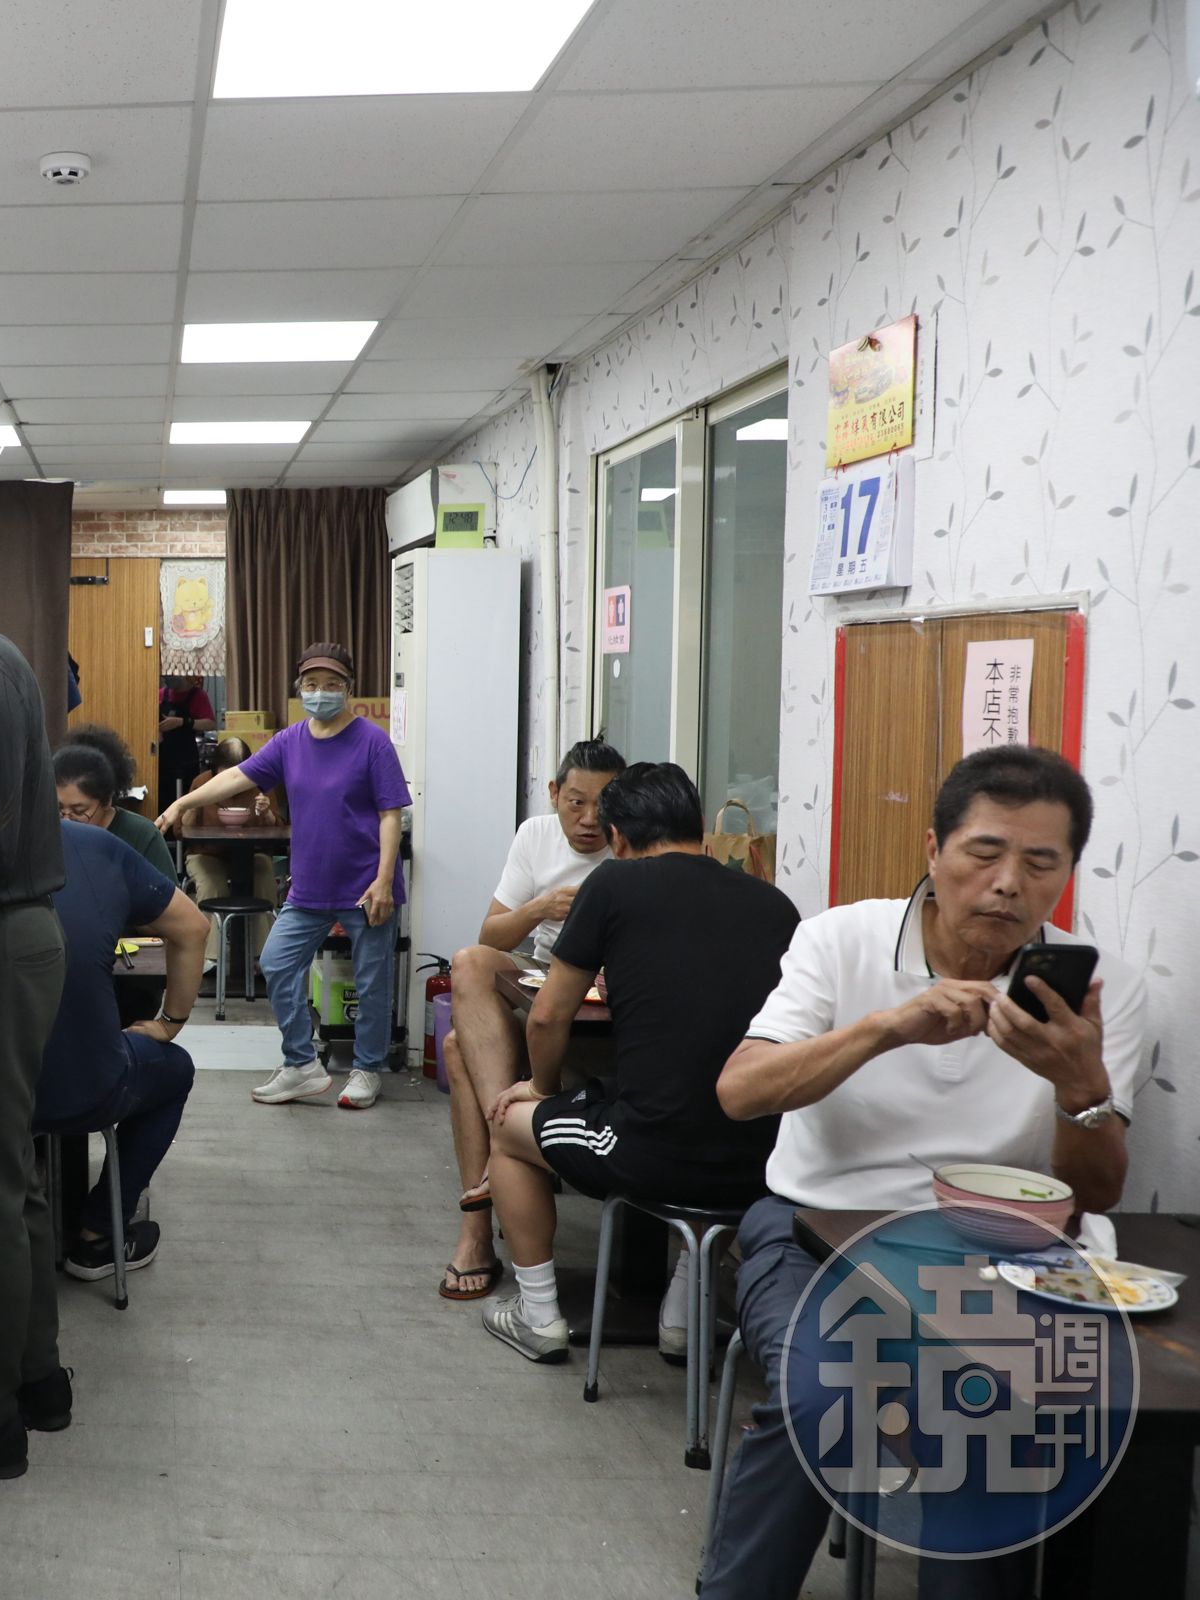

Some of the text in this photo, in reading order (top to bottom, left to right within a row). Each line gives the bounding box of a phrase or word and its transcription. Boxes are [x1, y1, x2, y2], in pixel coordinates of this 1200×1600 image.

[840, 476, 881, 558] 17
[982, 658, 1004, 745] 本店不
